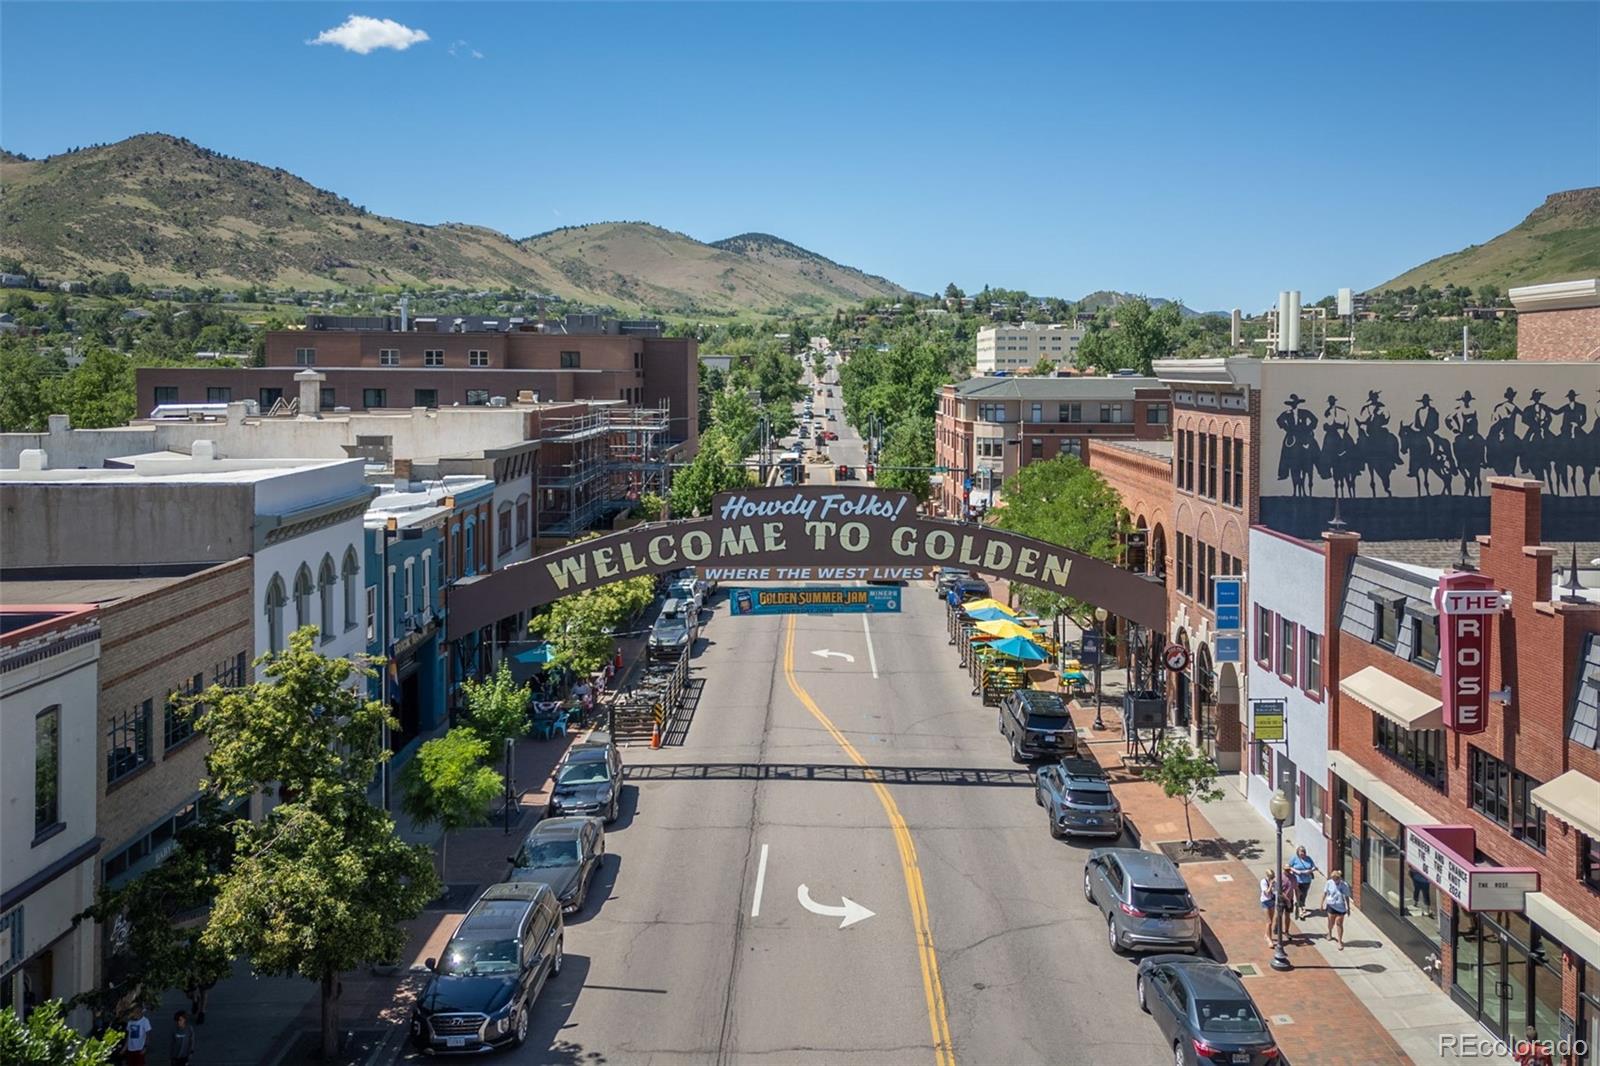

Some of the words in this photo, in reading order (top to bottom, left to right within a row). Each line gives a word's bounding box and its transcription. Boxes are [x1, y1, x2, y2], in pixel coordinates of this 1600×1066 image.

[720, 494, 816, 521] Howdy
[819, 494, 908, 522] Folks!
[545, 521, 786, 591] WELCOME
[804, 521, 871, 552] TO
[890, 526, 1072, 587] GOLDEN
[704, 568, 769, 580] WHERE
[775, 568, 813, 580] THE
[817, 567, 868, 580] WEST
[873, 567, 924, 580] LIVES
[759, 592, 799, 605] GOLDEN
[800, 592, 843, 605] SUMMER
[844, 591, 867, 604] JAM
[1449, 596, 1498, 611] THE
[1457, 619, 1481, 724] ROSE
